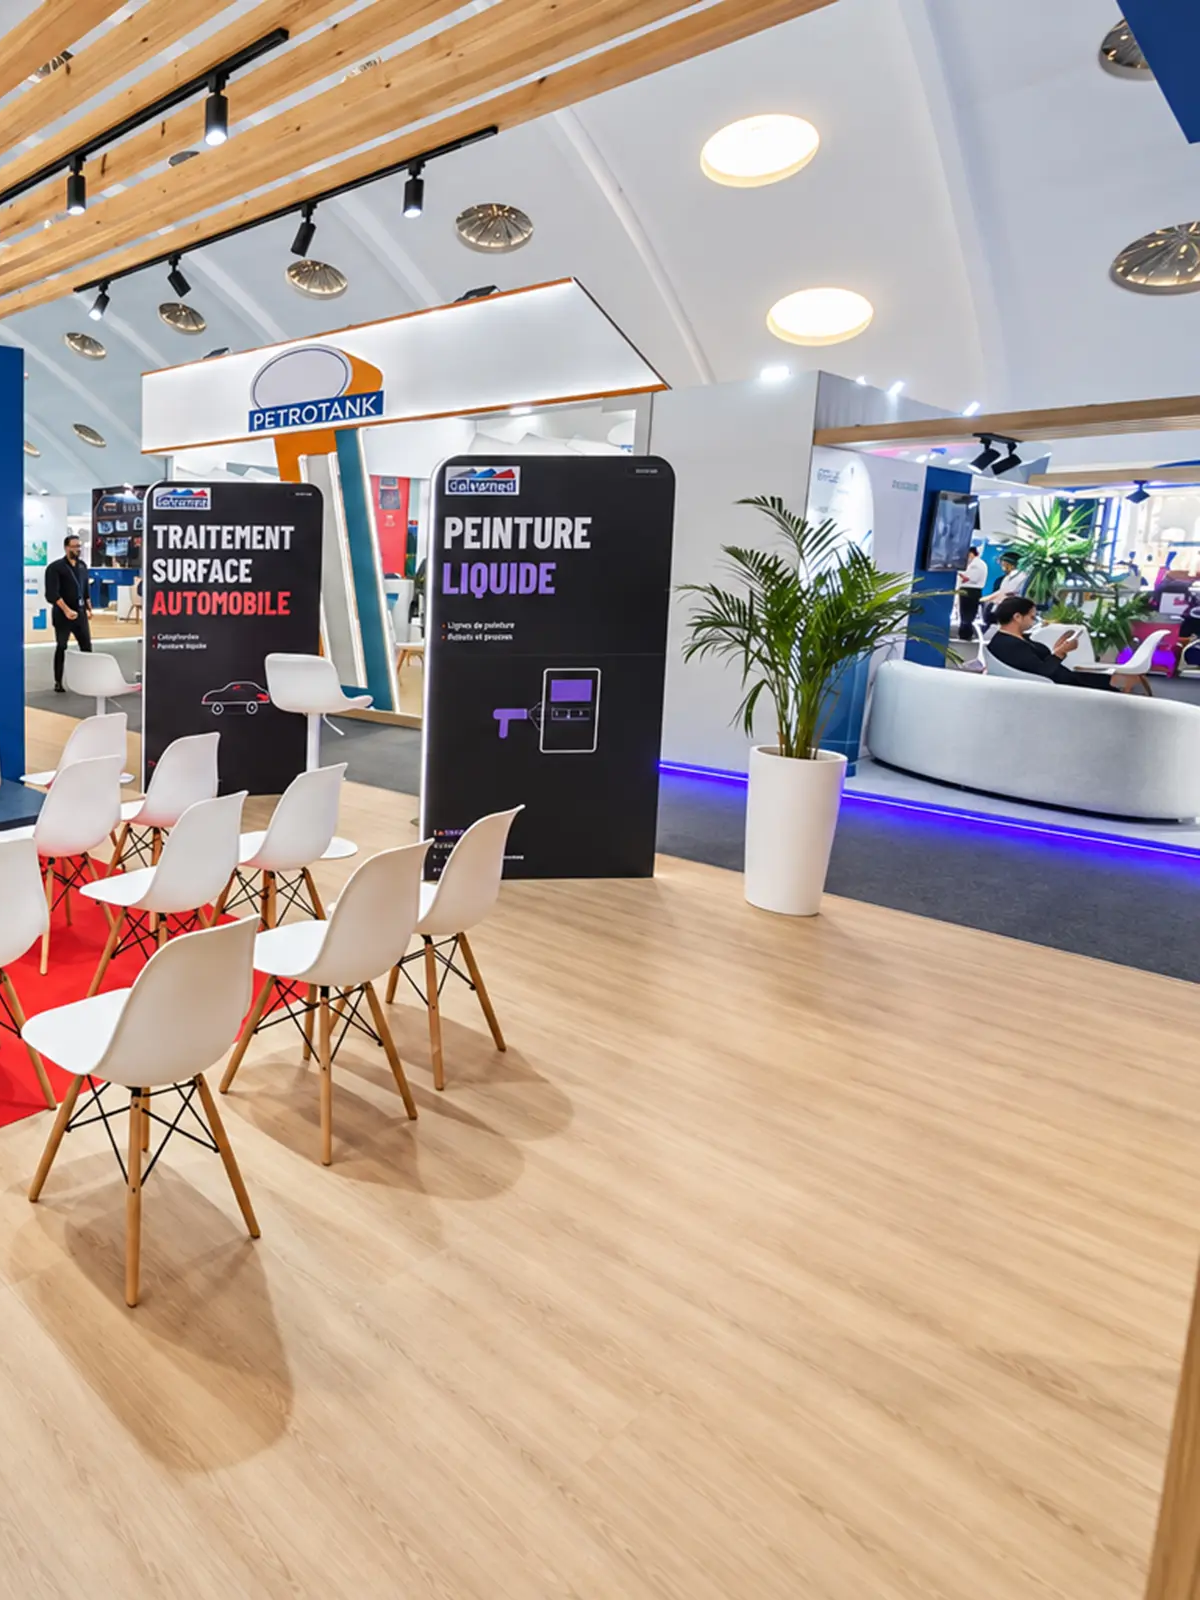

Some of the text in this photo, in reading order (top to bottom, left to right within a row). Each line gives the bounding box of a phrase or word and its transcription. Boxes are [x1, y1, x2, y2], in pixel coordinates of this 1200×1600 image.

[253, 395, 377, 430] PETROTANK
[152, 525, 295, 550] TRAITEMENT
[443, 517, 592, 549] PEINTURE
[152, 558, 252, 583] SURFACE
[442, 562, 557, 599] LIQUIDE
[151, 590, 292, 616] AUTOMOBILE
